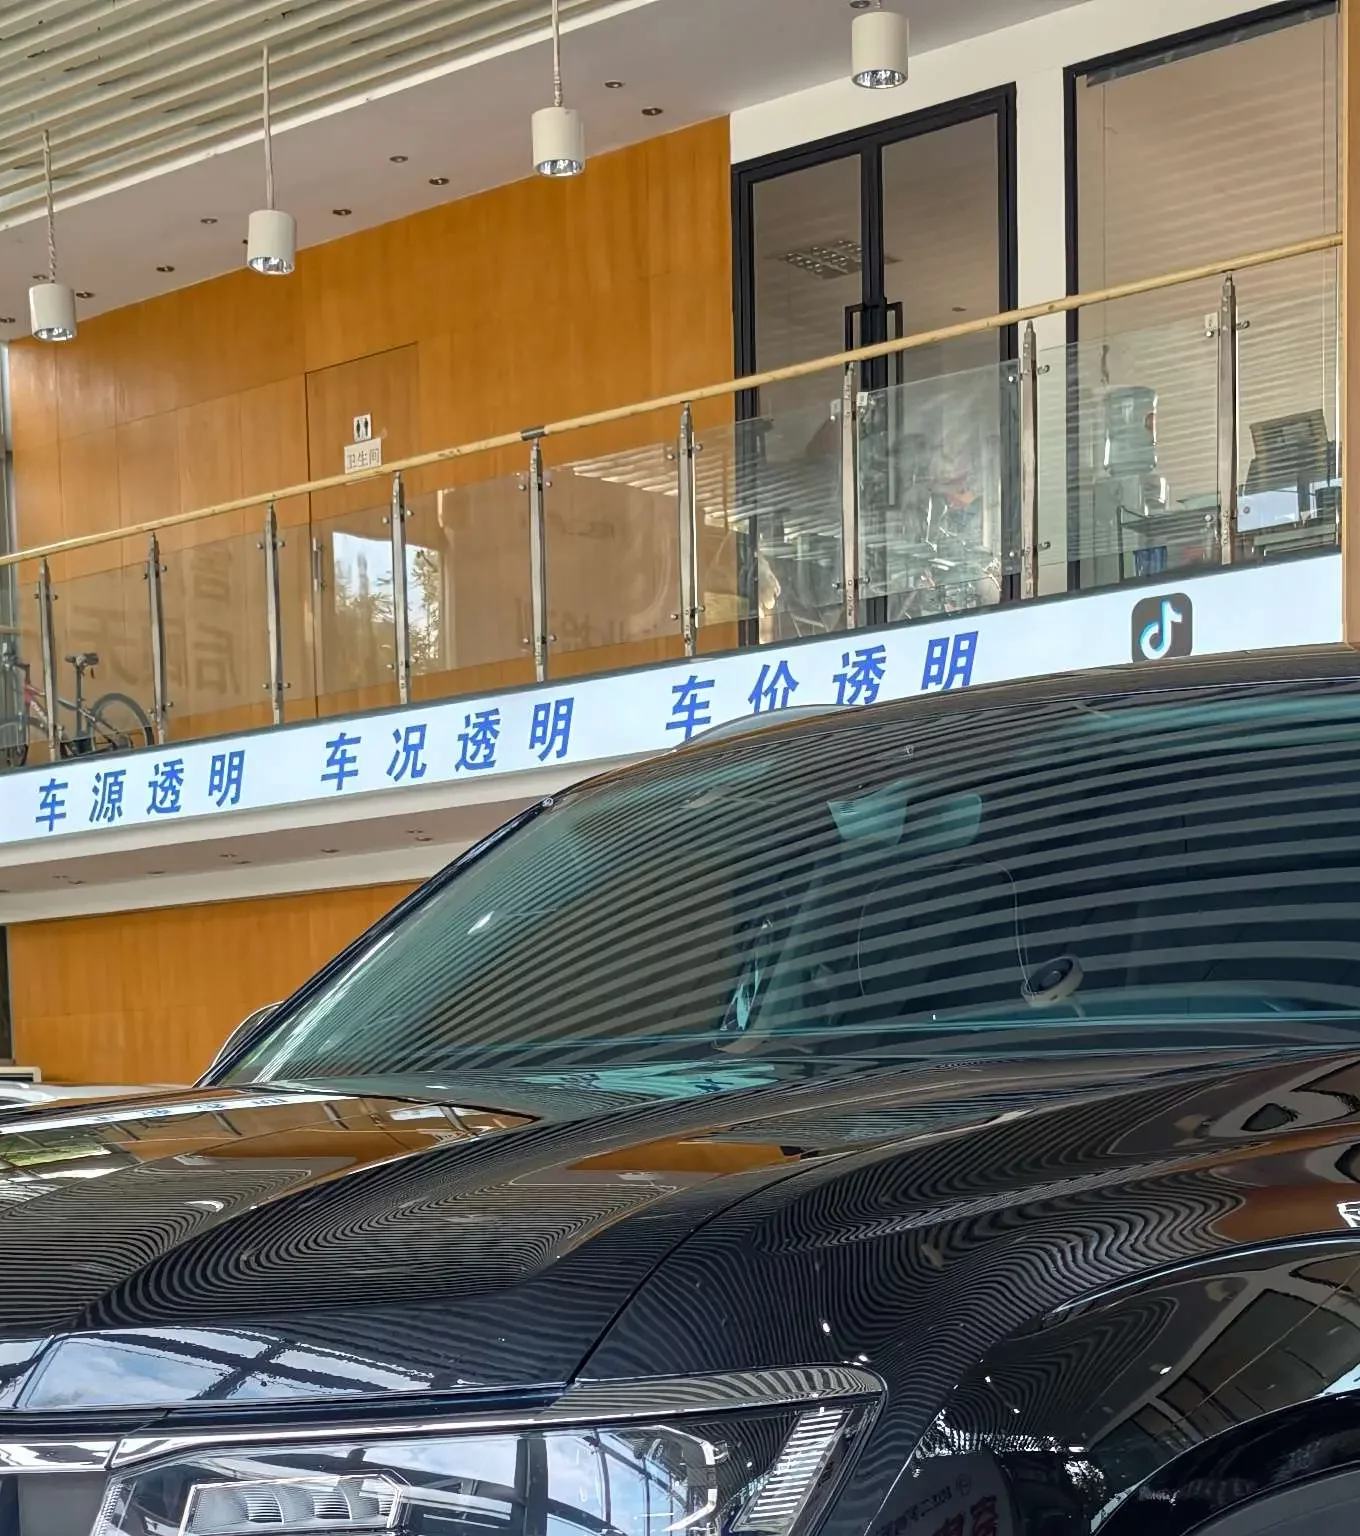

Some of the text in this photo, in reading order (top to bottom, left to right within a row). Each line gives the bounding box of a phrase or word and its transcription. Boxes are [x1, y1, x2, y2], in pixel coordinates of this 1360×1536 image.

[347, 448, 379, 469] 卫生间
[35, 630, 979, 832] 车源透明 车况透明 车价透明
